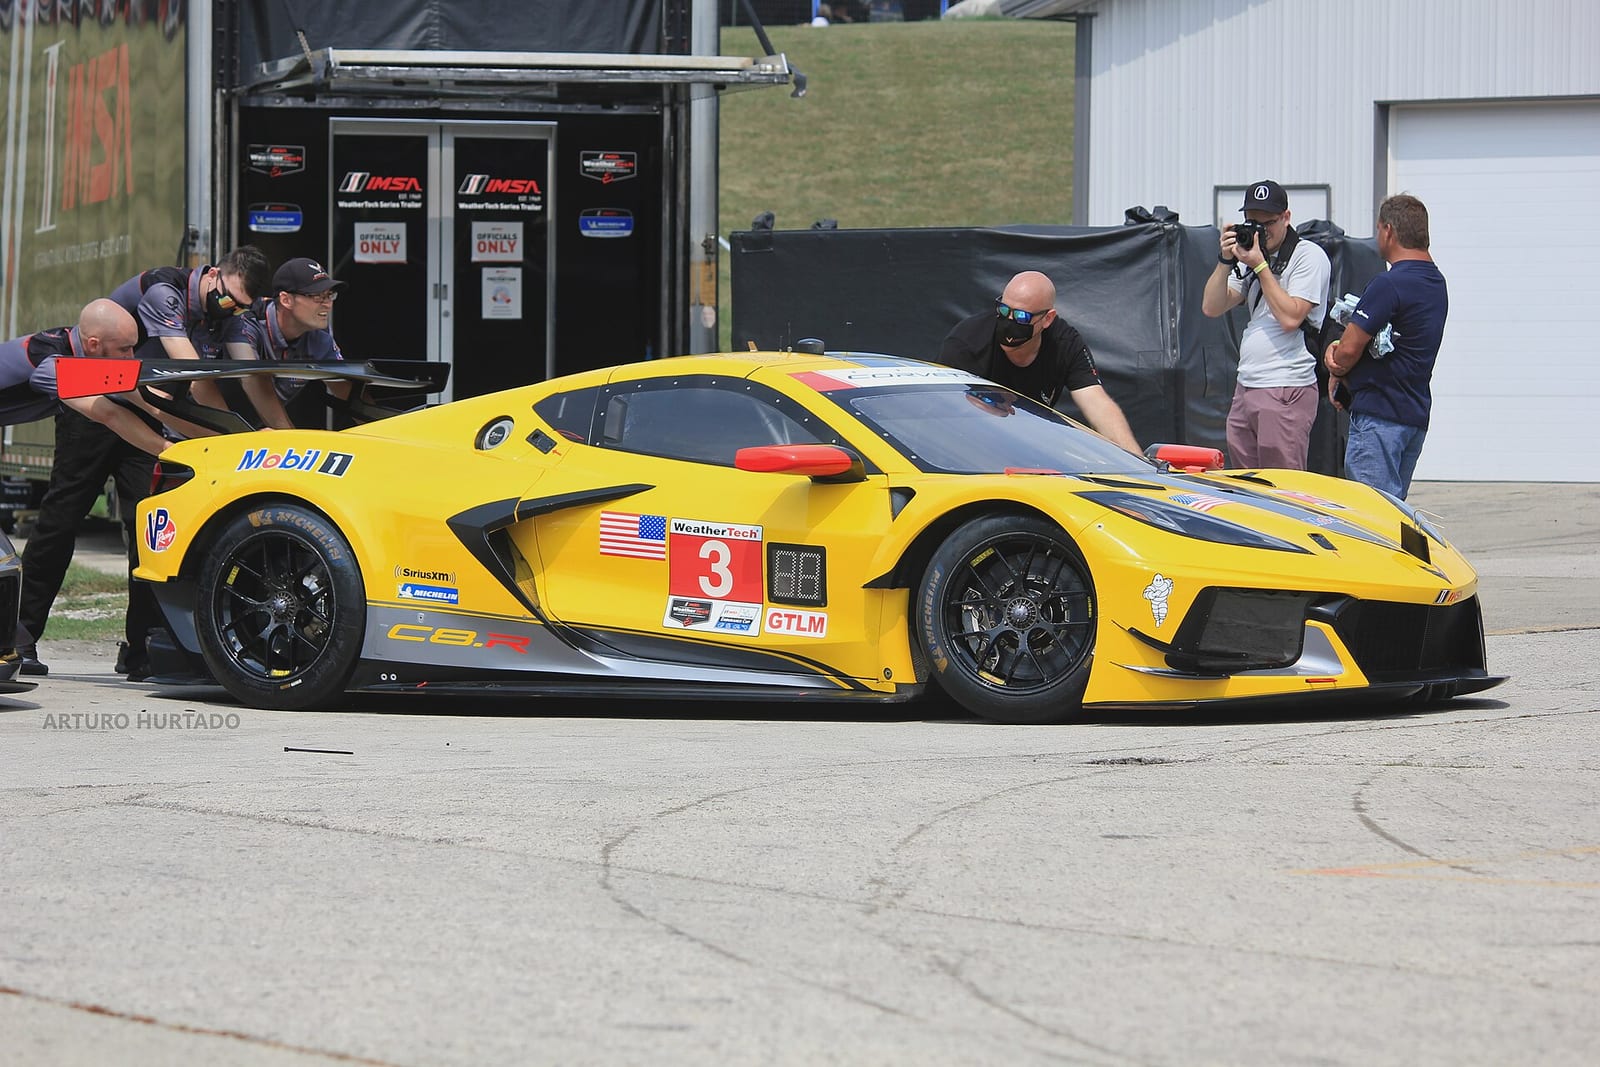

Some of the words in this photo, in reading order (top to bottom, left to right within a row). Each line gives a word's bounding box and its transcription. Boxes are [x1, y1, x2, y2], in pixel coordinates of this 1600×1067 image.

[365, 176, 420, 191] IMSA
[485, 179, 540, 192] IMSA
[458, 202, 499, 210] WeatherTech
[520, 203, 542, 211] Trailer
[360, 233, 400, 241] OFFICIALS
[477, 233, 518, 241] OFFICIALS
[360, 241, 400, 254] ONLY
[477, 241, 517, 253] ONLY
[236, 449, 321, 471] Mobil
[148, 508, 168, 551] VP
[276, 511, 341, 560] MICHELIN
[673, 521, 757, 539] WeatherTech
[698, 539, 734, 598] 3
[413, 589, 458, 600] MICHELIN
[924, 569, 941, 645] MICHELIN
[768, 612, 825, 634] GTLM
[387, 623, 531, 654] C8.R
